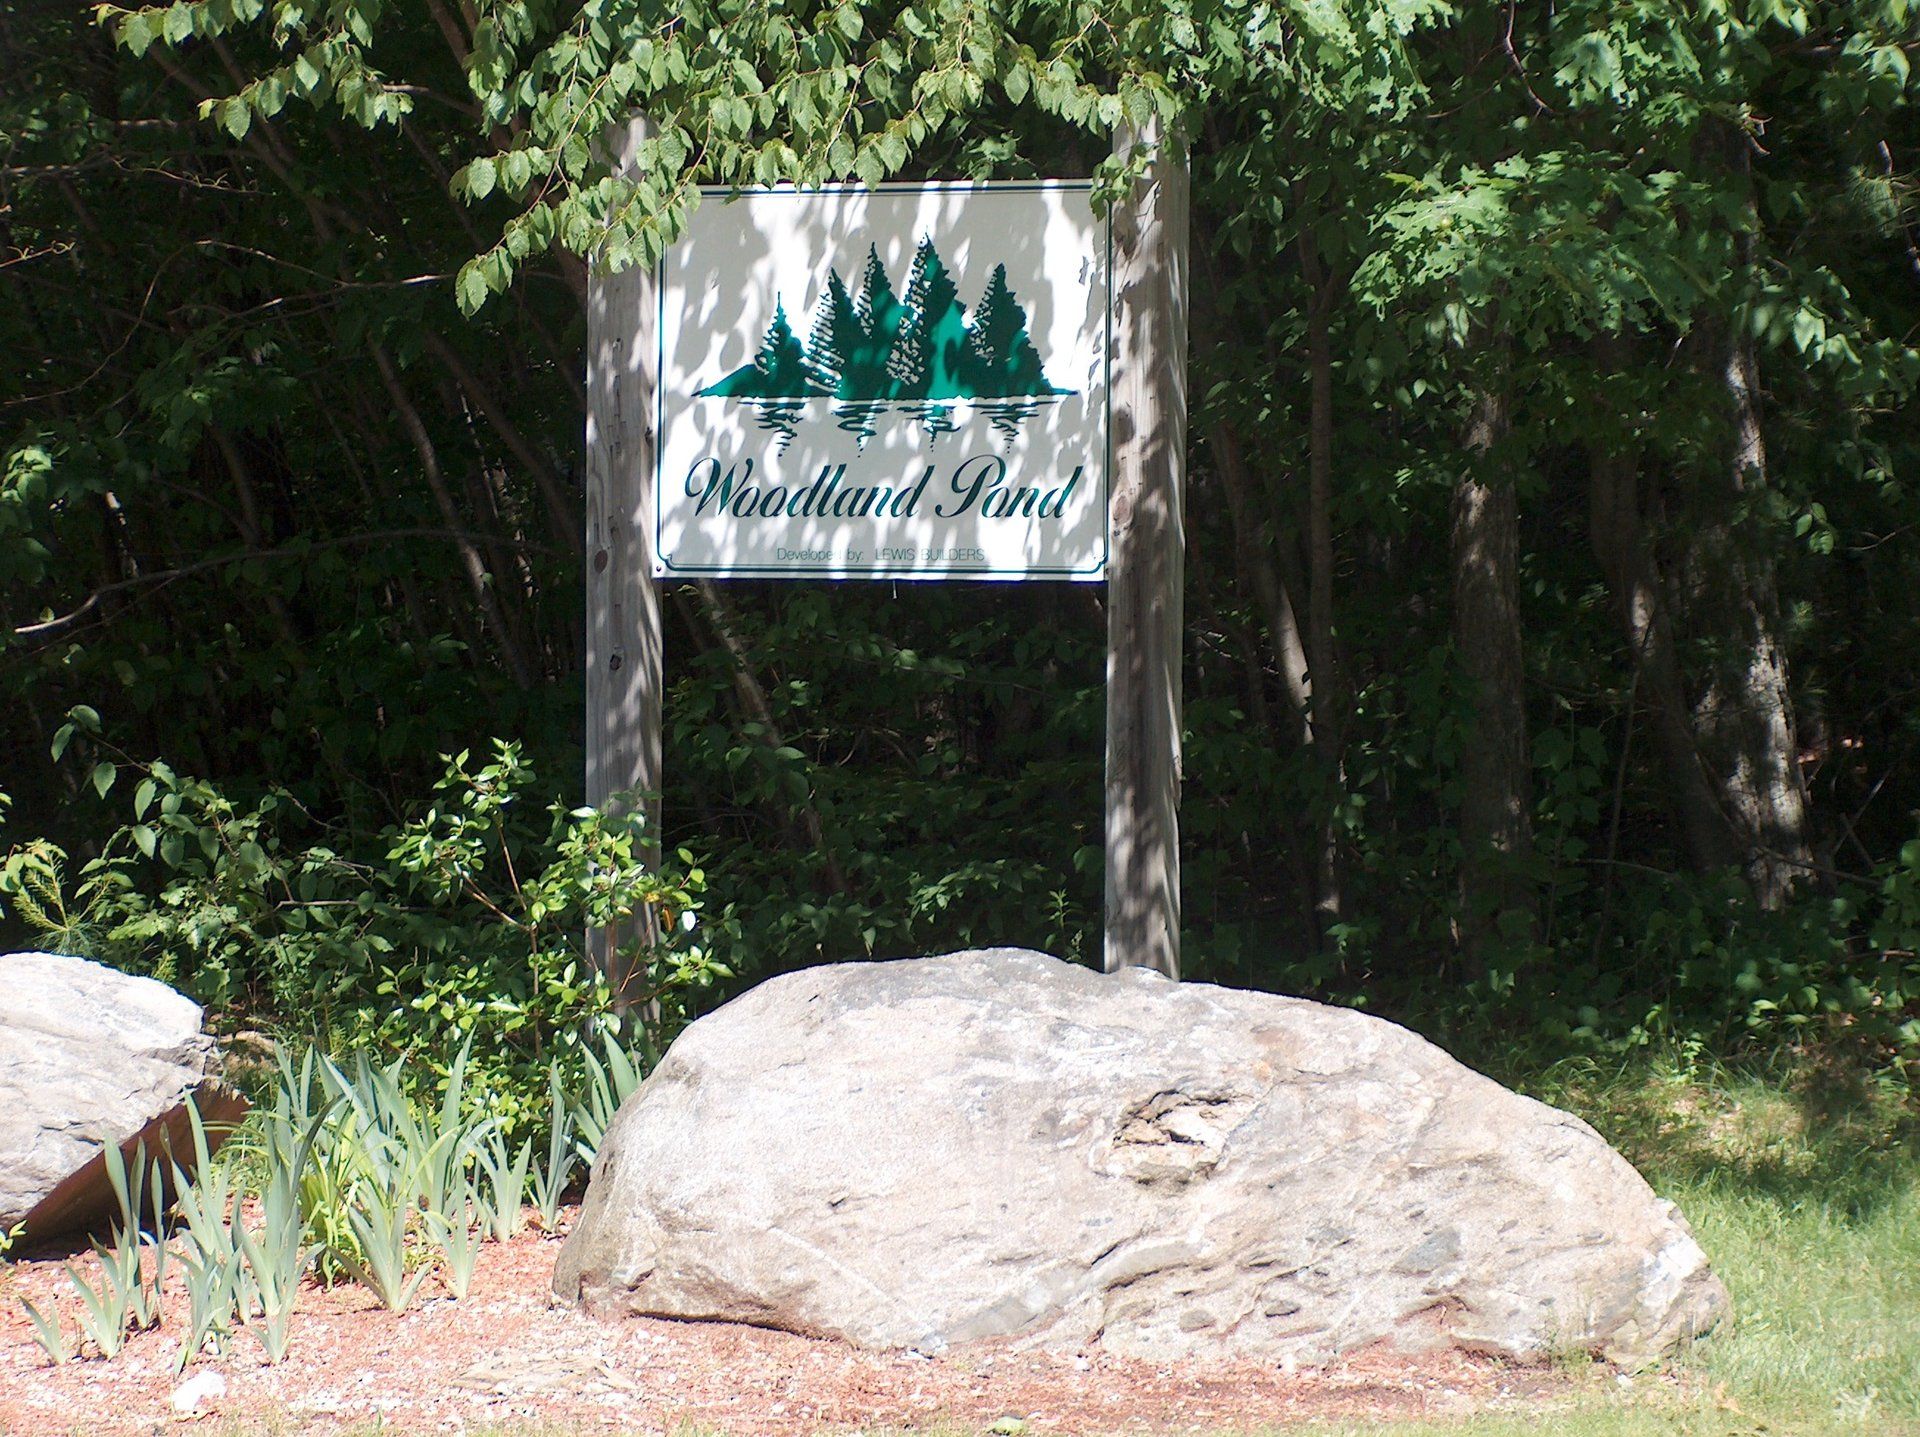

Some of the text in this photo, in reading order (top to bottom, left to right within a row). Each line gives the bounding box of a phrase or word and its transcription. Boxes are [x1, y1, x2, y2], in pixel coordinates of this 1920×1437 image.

[685, 454, 1083, 518] Woodland Pond
[875, 548, 915, 561] LEWIS
[921, 548, 985, 561] BUILDERS
